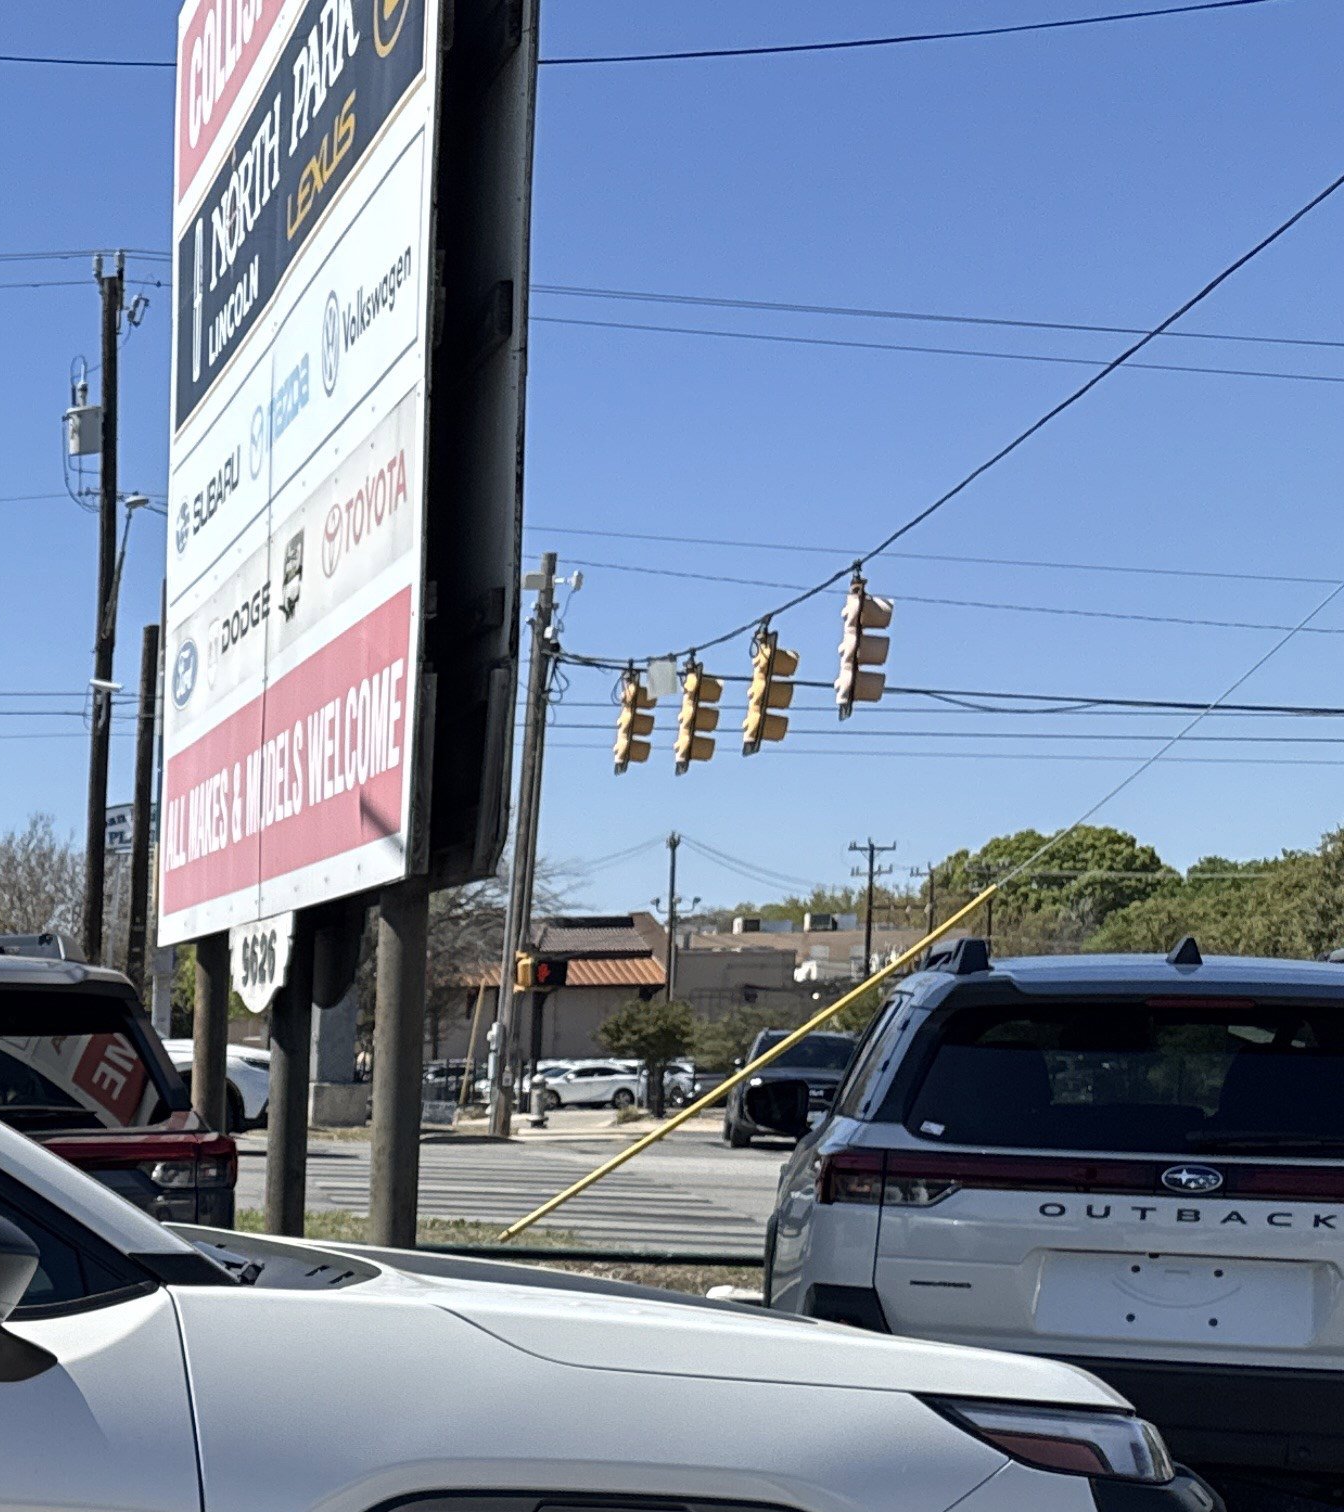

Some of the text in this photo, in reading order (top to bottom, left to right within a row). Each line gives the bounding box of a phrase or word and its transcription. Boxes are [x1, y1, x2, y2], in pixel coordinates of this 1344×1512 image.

[189, 0, 263, 149] COLLI
[210, 0, 360, 292] NORTH PARK
[287, 89, 357, 242] LEXUS
[208, 254, 259, 367] LINCOLN
[342, 245, 411, 352] Volkswagen
[193, 445, 241, 536] SUBARU
[346, 449, 407, 553] TOYOTA
[221, 581, 271, 654] DODGE
[165, 658, 404, 871] ALL MAKES & MODELS WELCOME
[242, 929, 277, 987] 9626
[1038, 1202, 1338, 1229] OUTBACK
